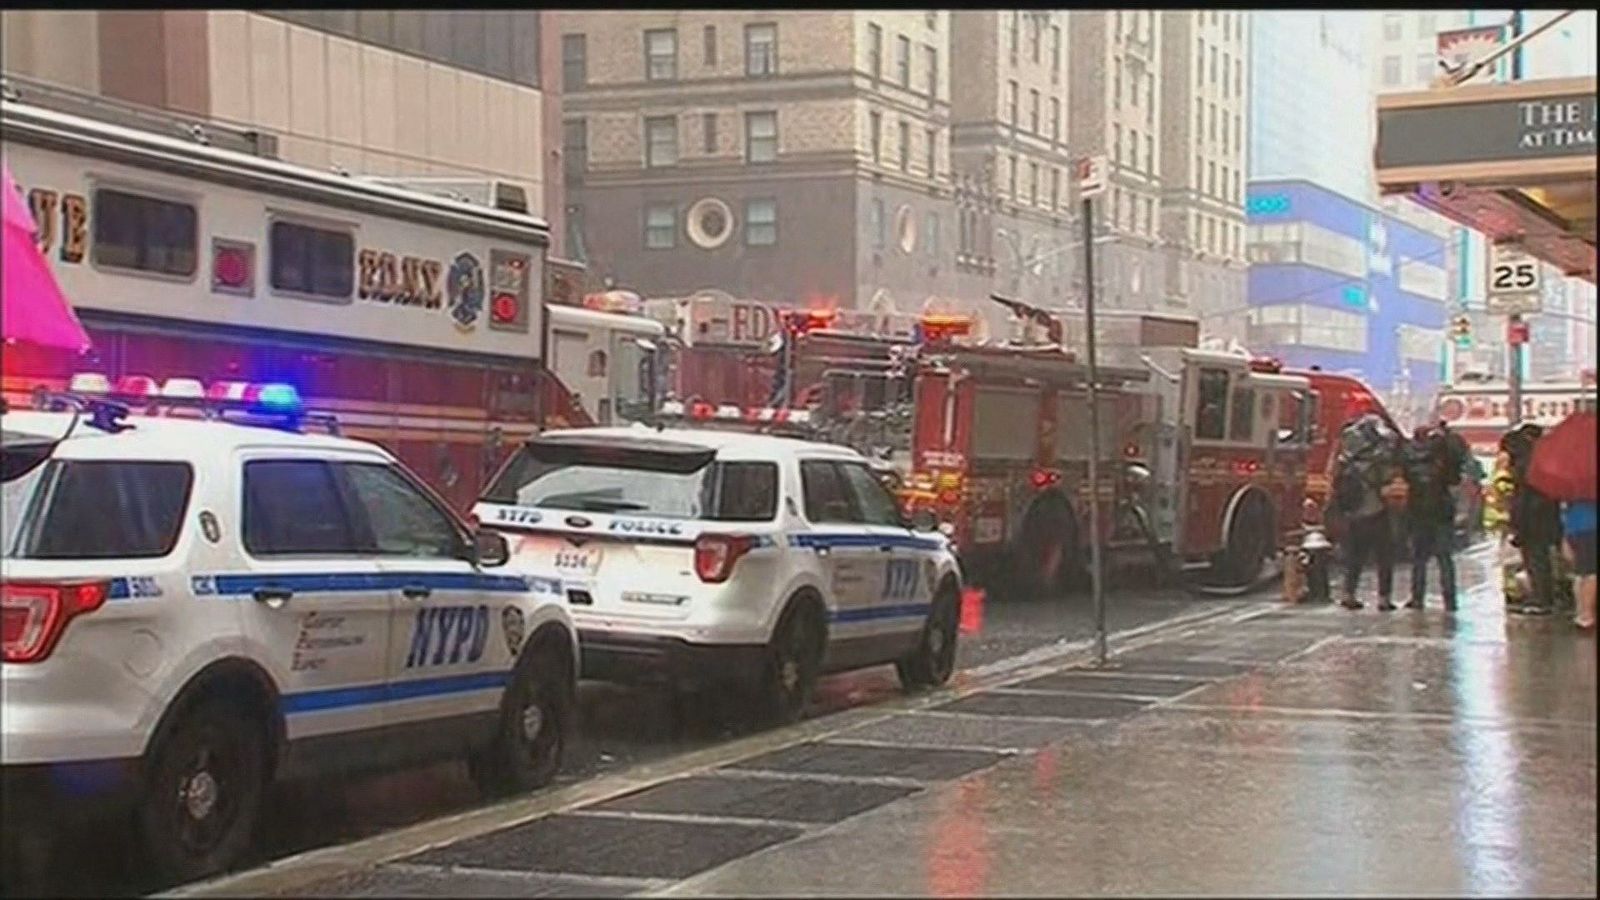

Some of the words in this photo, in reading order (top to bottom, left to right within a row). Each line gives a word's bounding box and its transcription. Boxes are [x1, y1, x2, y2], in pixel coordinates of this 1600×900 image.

[1518, 102, 1579, 125] THE
[1518, 133, 1546, 148] AT
[1494, 264, 1535, 288] 25
[609, 519, 682, 536] POLICE
[405, 604, 490, 669] NYPD
